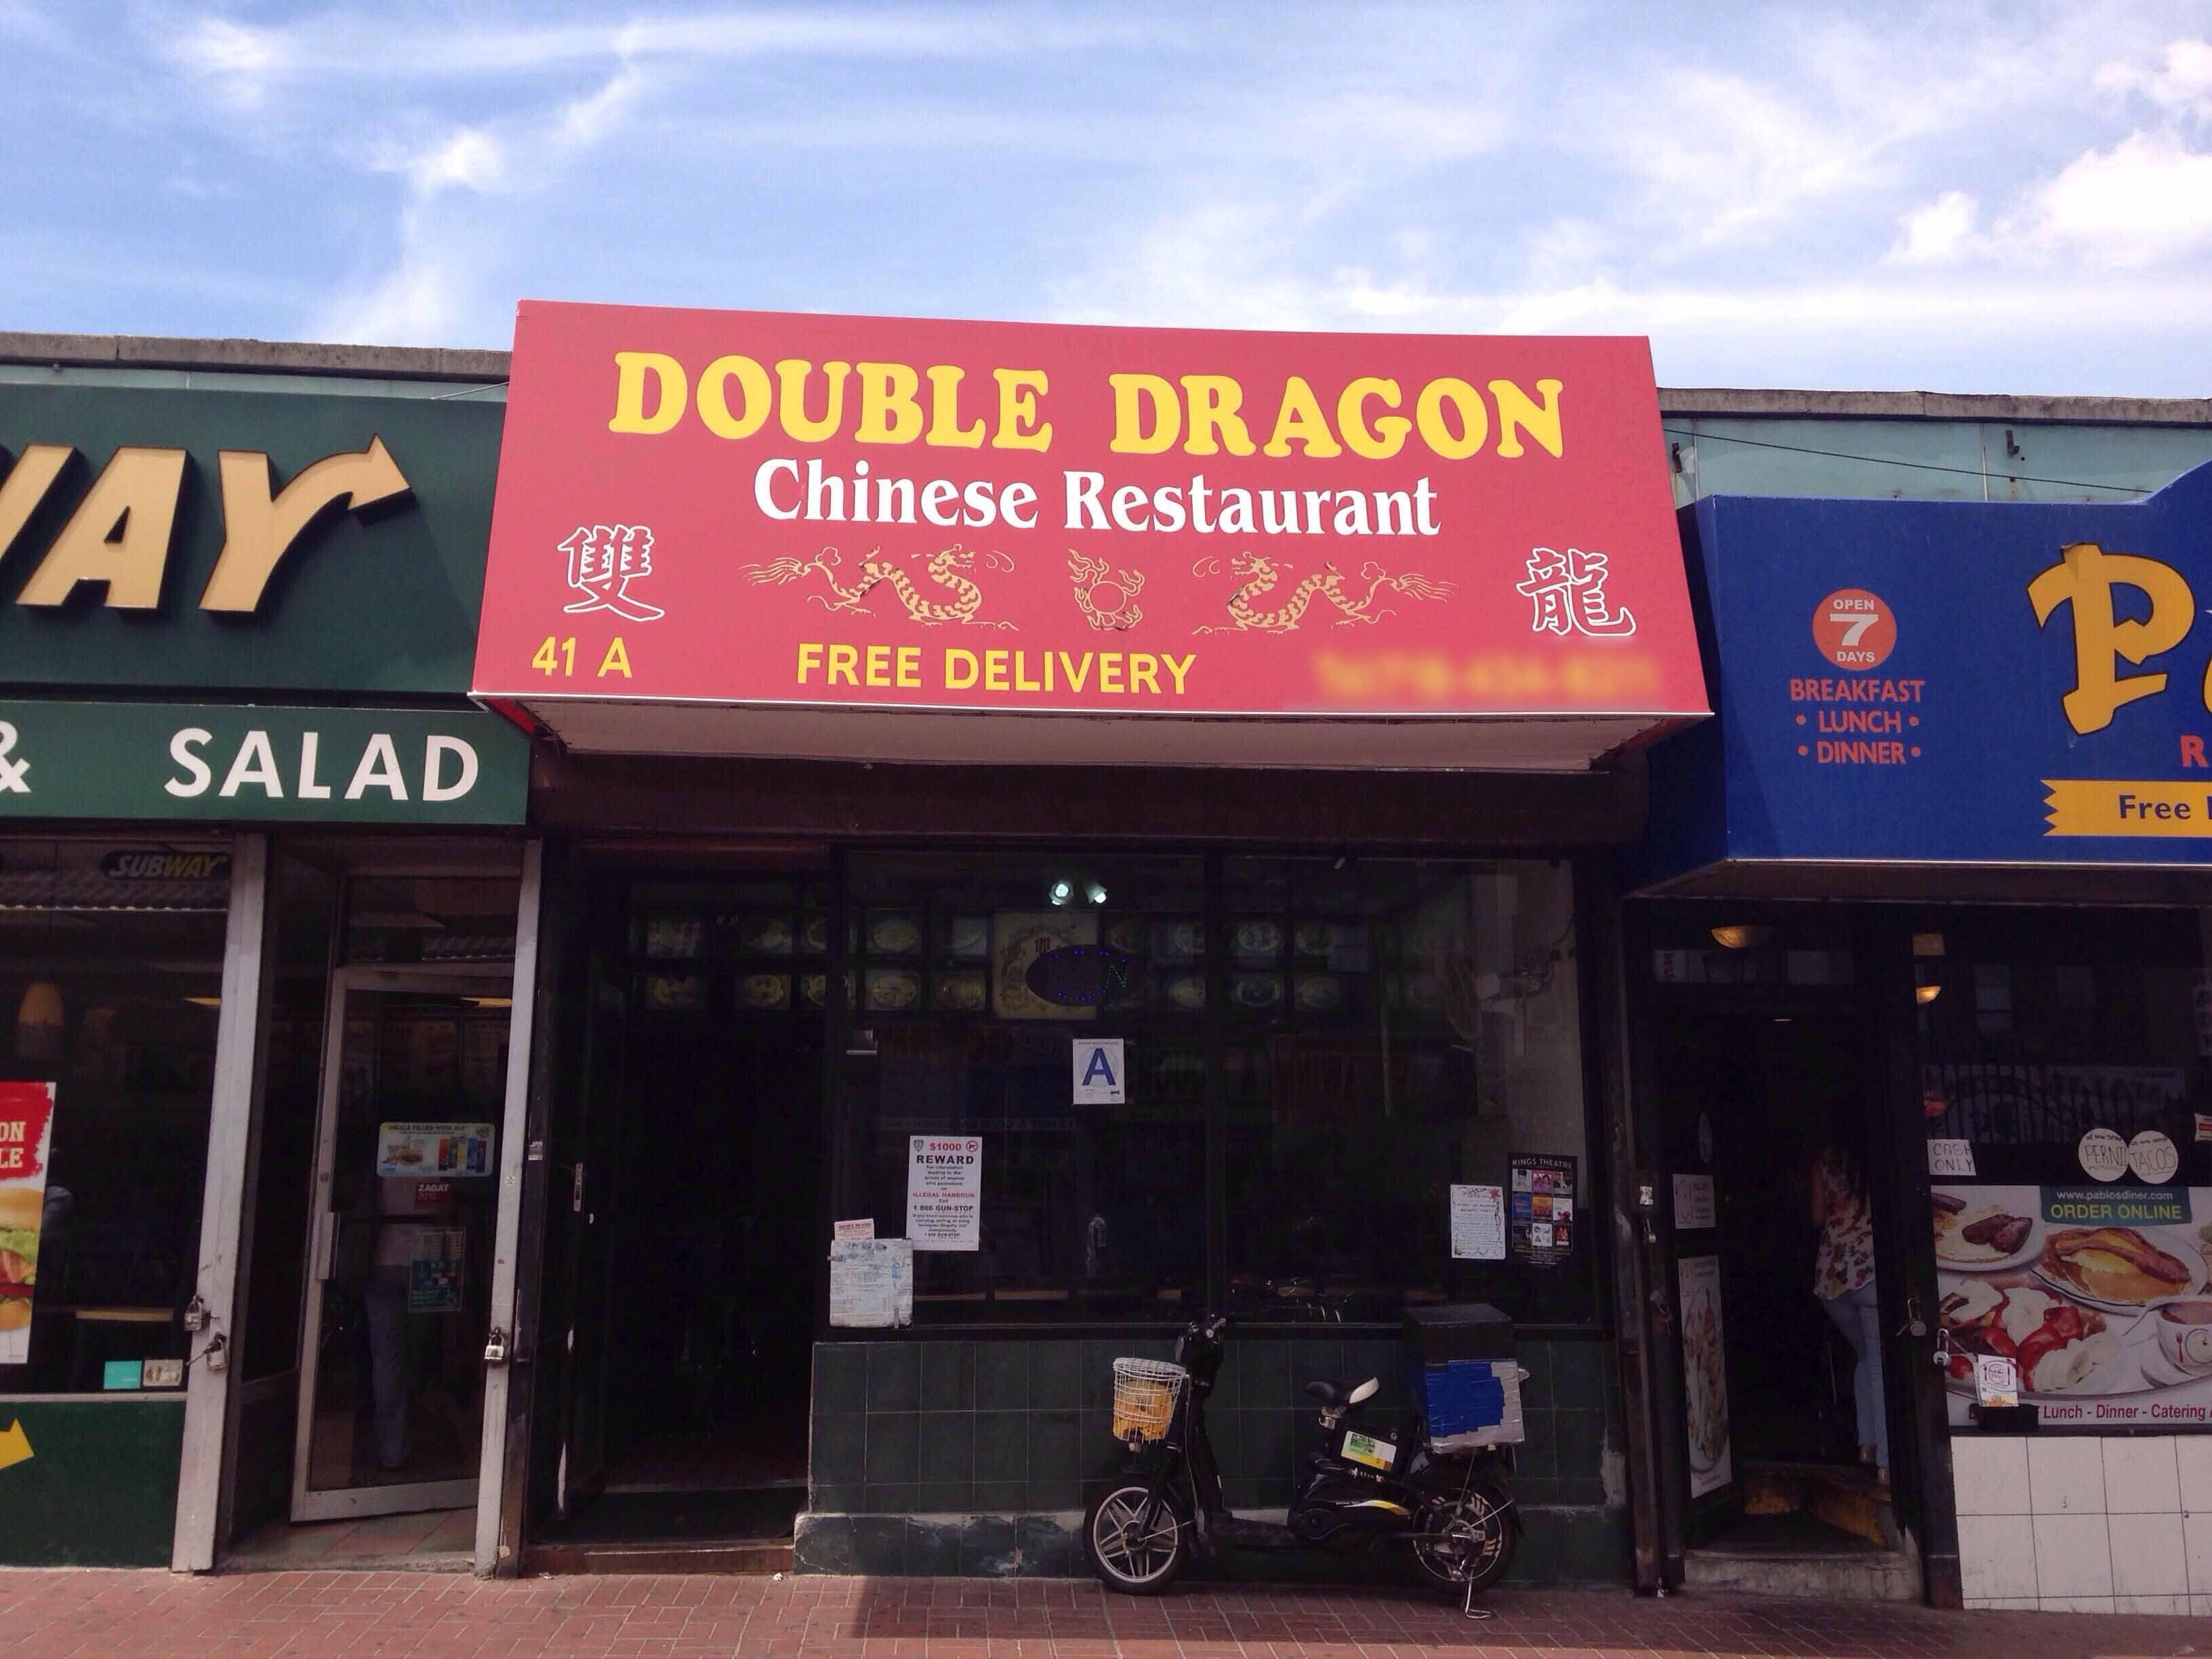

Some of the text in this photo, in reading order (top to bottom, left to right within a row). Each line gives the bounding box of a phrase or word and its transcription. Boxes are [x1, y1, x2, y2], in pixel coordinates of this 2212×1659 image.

[609, 351, 1564, 459] DOUBLE DRAGON
[754, 458, 1441, 536] Chinese Restaurant
[0, 434, 410, 612] AY
[558, 524, 664, 622] 雙
[1515, 547, 1637, 637] 龍
[1833, 599, 1875, 611] OPEN
[1830, 613, 1879, 647] 7
[531, 636, 634, 679] 41 A
[797, 643, 1197, 695] FREE DELIVERY
[1836, 651, 1876, 663] DAYS
[1790, 680, 1924, 702] BREAKFAST
[1818, 710, 1902, 734] LUNCH
[164, 727, 479, 802] SALAD
[1816, 741, 1906, 765] DINNER
[2118, 795, 2191, 820] Free
[108, 855, 228, 878] SUBWAY
[1082, 1048, 1115, 1085] A
[916, 1154, 974, 1164] REWARD
[1933, 1143, 1971, 1156] CASH
[2085, 1145, 2127, 1166] PERNIL
[2129, 1146, 2175, 1172] TACOS
[1540, 1158, 1573, 1168] THEATRE
[1935, 1158, 1972, 1172] ONLY
[418, 1184, 449, 1192] ZAGAT
[2056, 1189, 2173, 1201] www.pablosdiner.com
[2050, 1204, 2182, 1219] ORDER ONLINE
[2043, 1404, 2083, 1419] Lunch
[2095, 1404, 2139, 1419] Dinner
[2150, 1404, 2206, 1421] Catering
